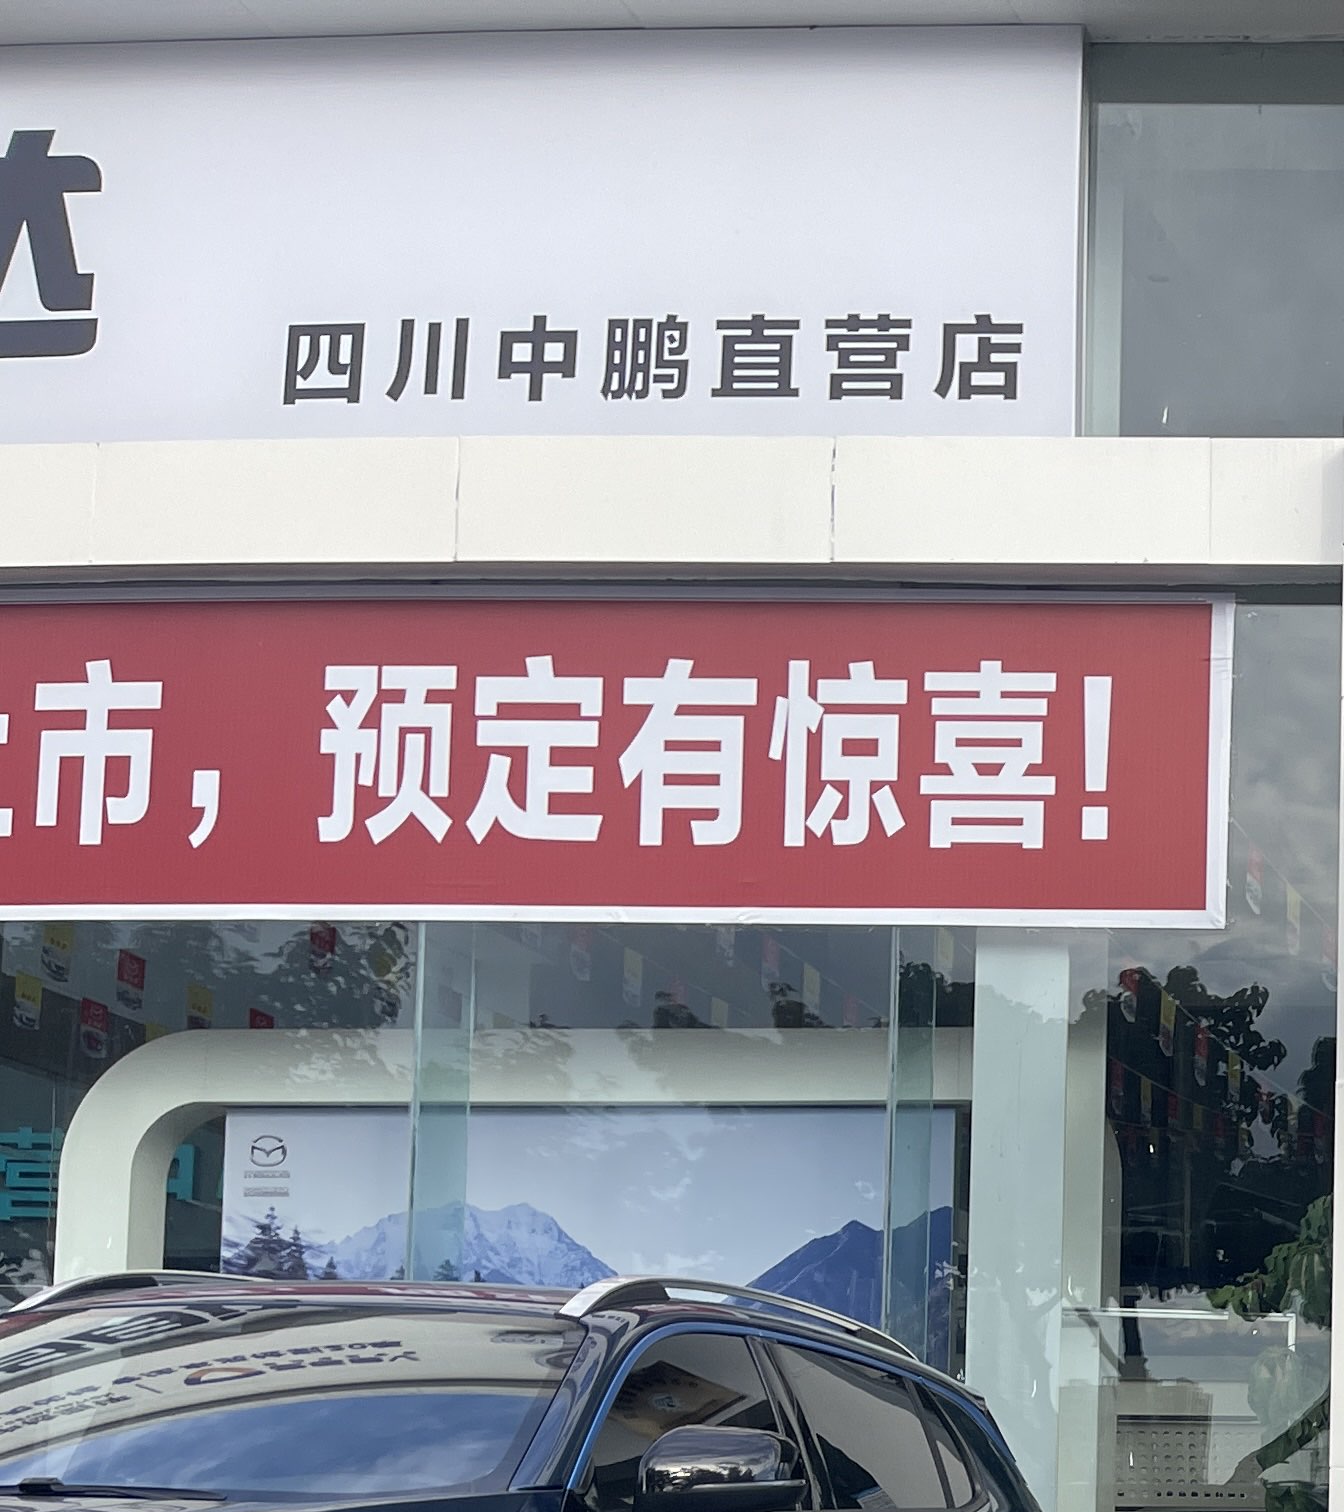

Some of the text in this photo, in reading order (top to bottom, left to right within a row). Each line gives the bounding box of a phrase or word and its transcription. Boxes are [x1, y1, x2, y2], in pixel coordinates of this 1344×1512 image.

[282, 313, 1025, 405] 四川中鹏直营店
[0, 655, 1112, 852] 市，预定有惊喜！
